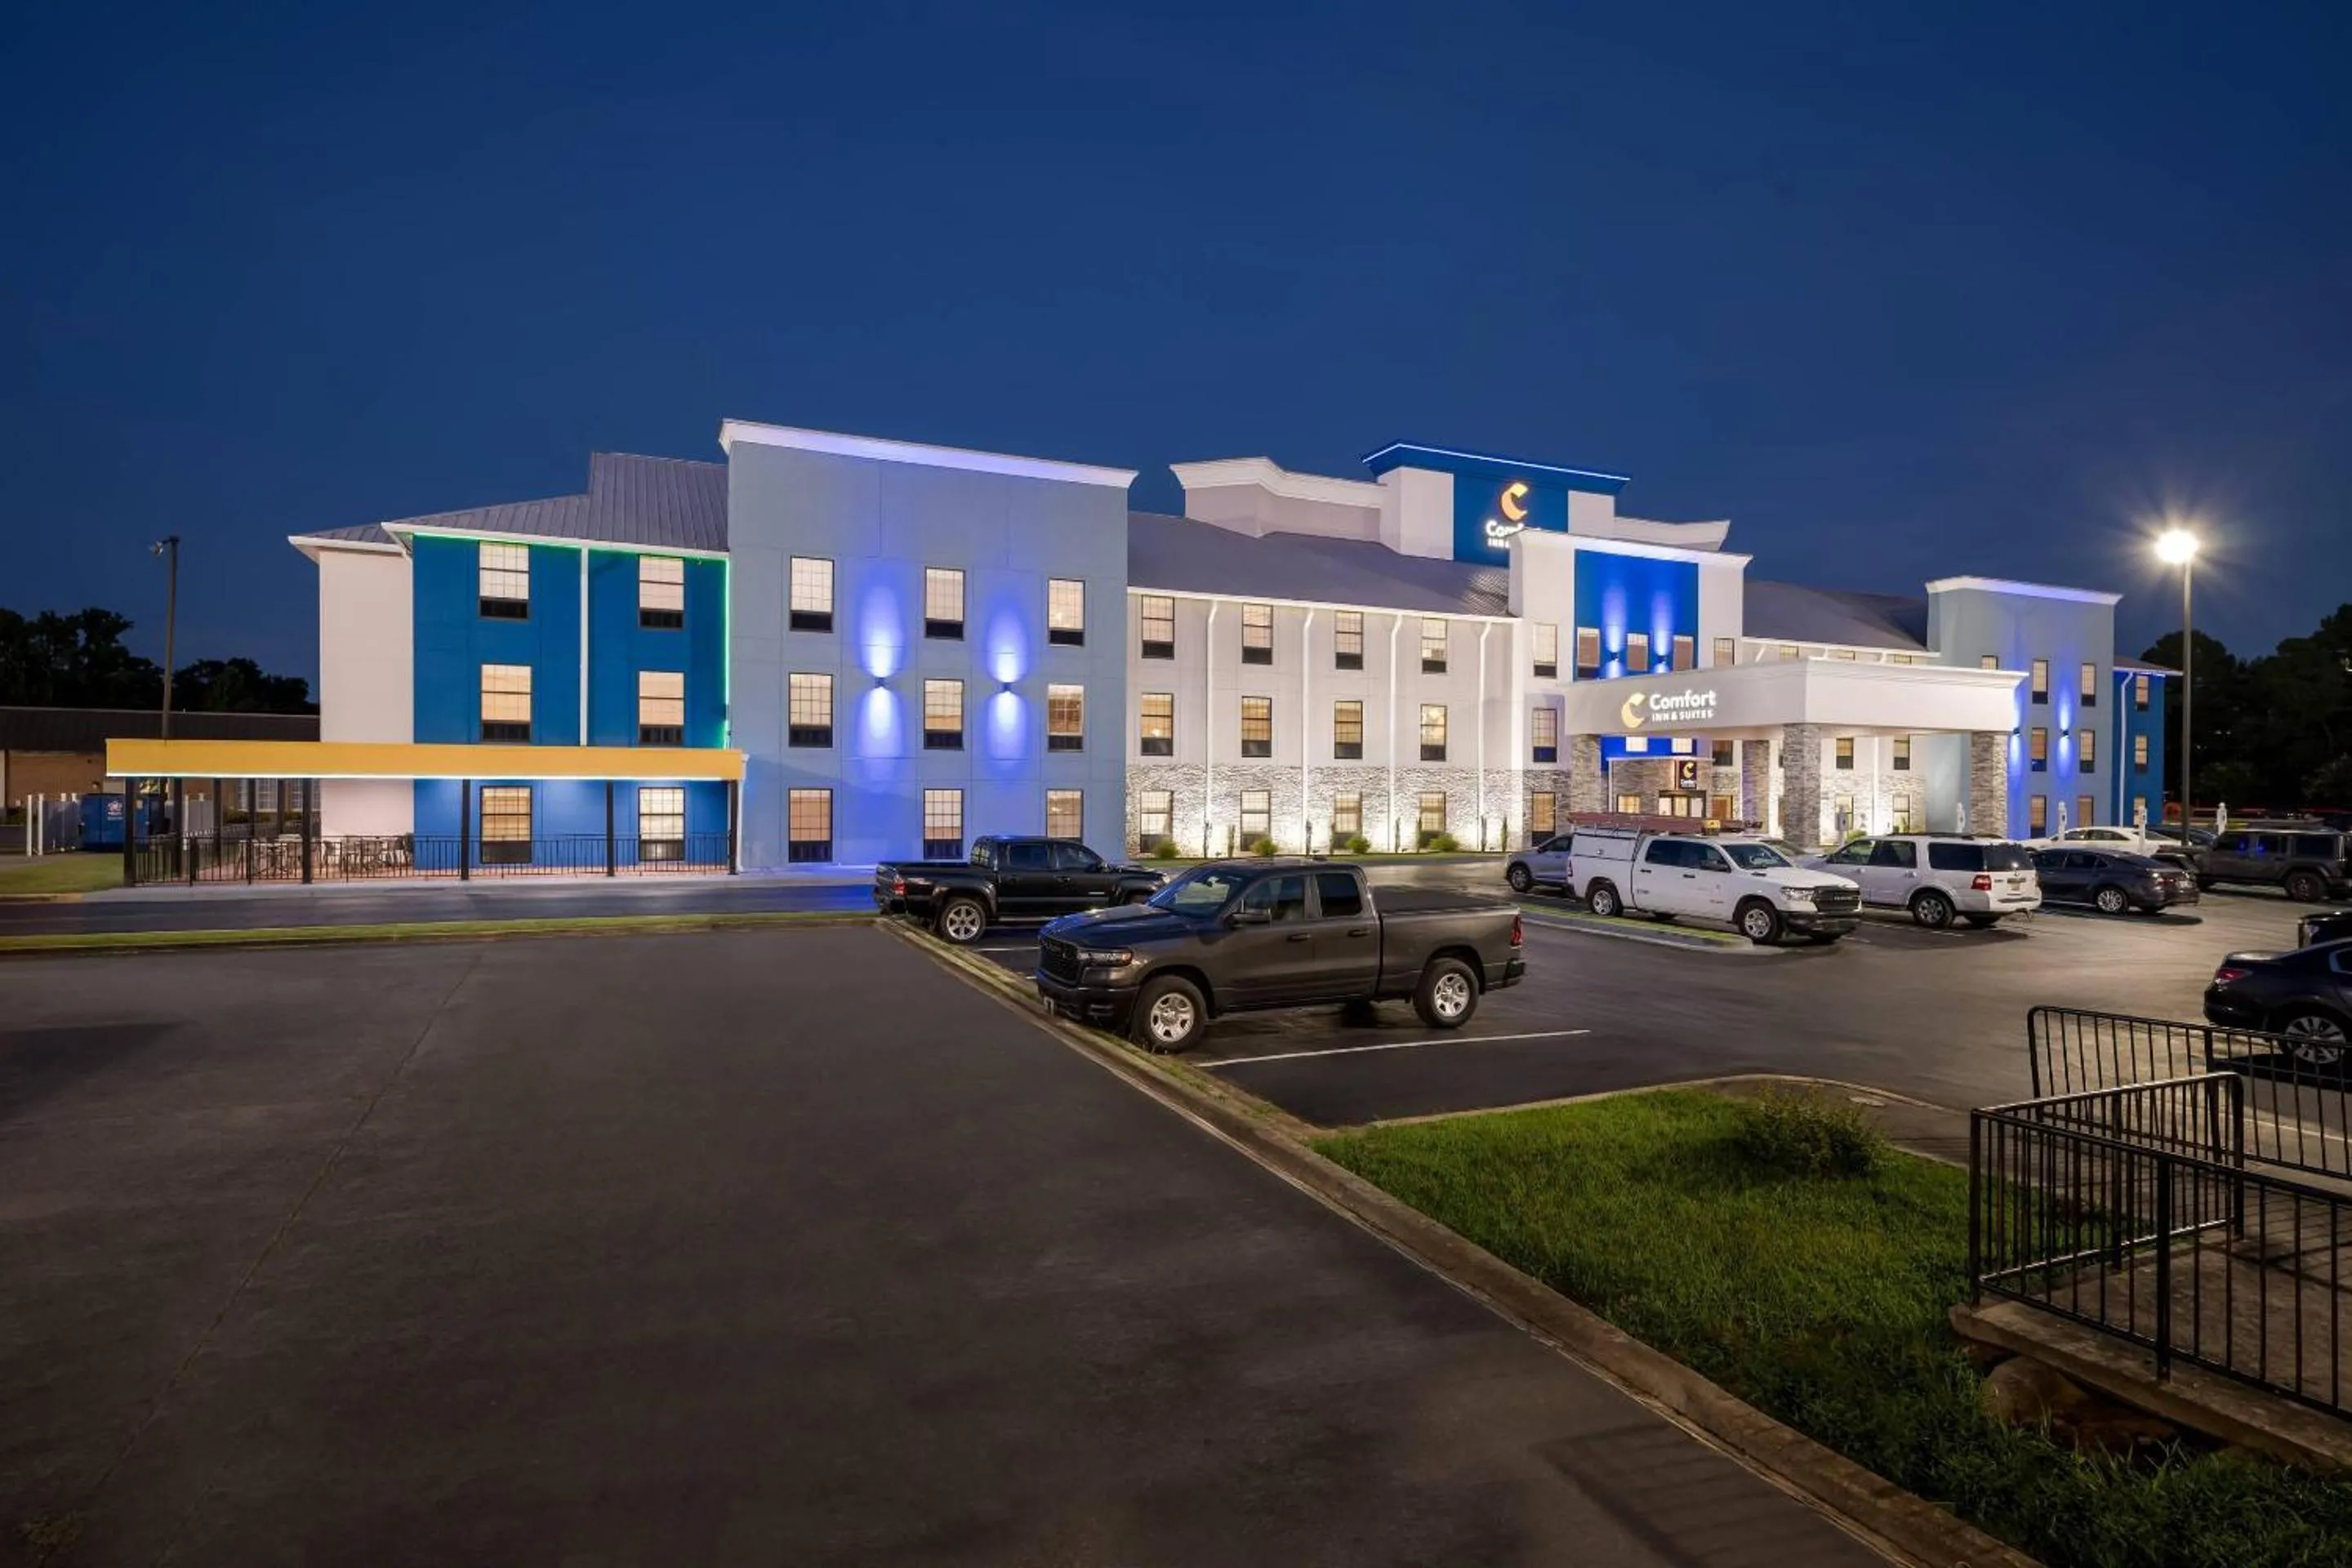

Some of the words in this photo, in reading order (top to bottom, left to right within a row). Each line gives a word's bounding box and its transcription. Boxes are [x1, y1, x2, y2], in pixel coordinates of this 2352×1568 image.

[1650, 689, 1717, 710] Comfort
[1651, 712, 1670, 722] INN
[1679, 709, 1714, 720] SUITES
